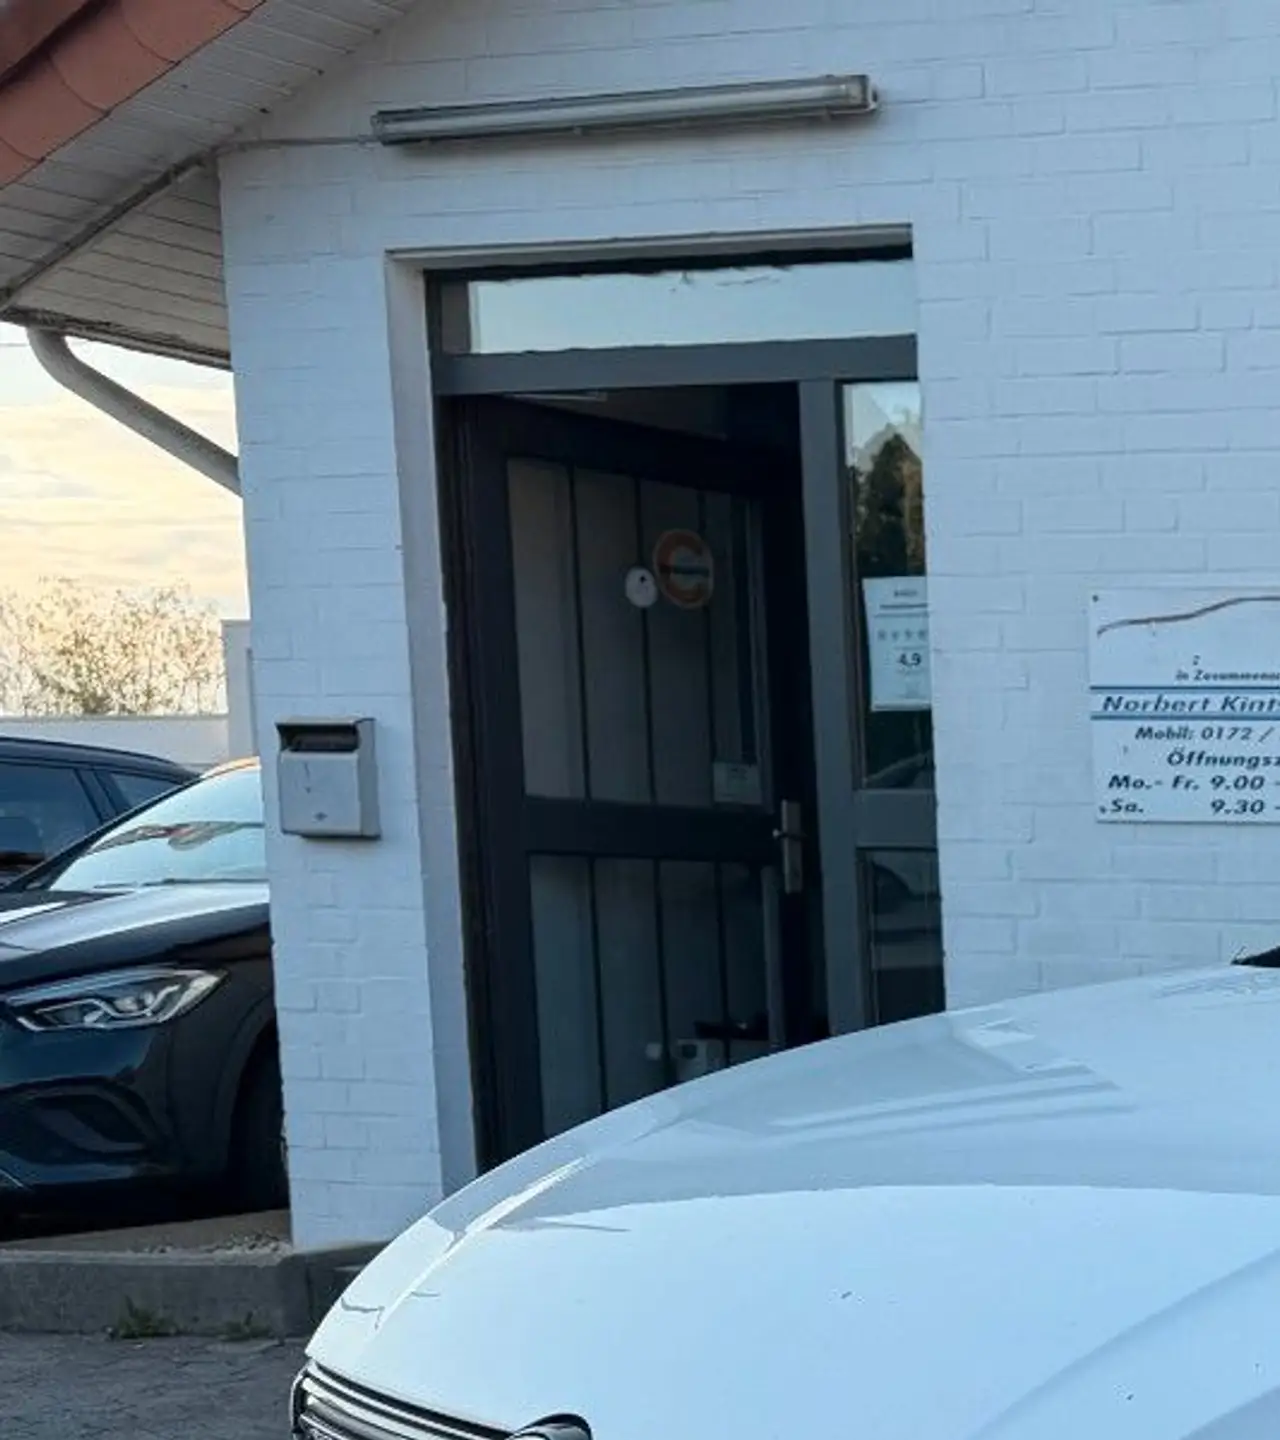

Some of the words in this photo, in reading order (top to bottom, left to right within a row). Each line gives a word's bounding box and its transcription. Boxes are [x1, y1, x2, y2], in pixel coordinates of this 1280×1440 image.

[1175, 669, 1190, 682] in
[1101, 695, 1210, 713] Norbert
[1135, 725, 1194, 741] Mobil:
[1201, 726, 1254, 741] 0172
[1258, 727, 1275, 744] /
[1171, 775, 1201, 791] Fr.
[1210, 775, 1266, 791] 9.00
[1110, 798, 1144, 814] Sa.
[1210, 799, 1266, 815] 9.30
